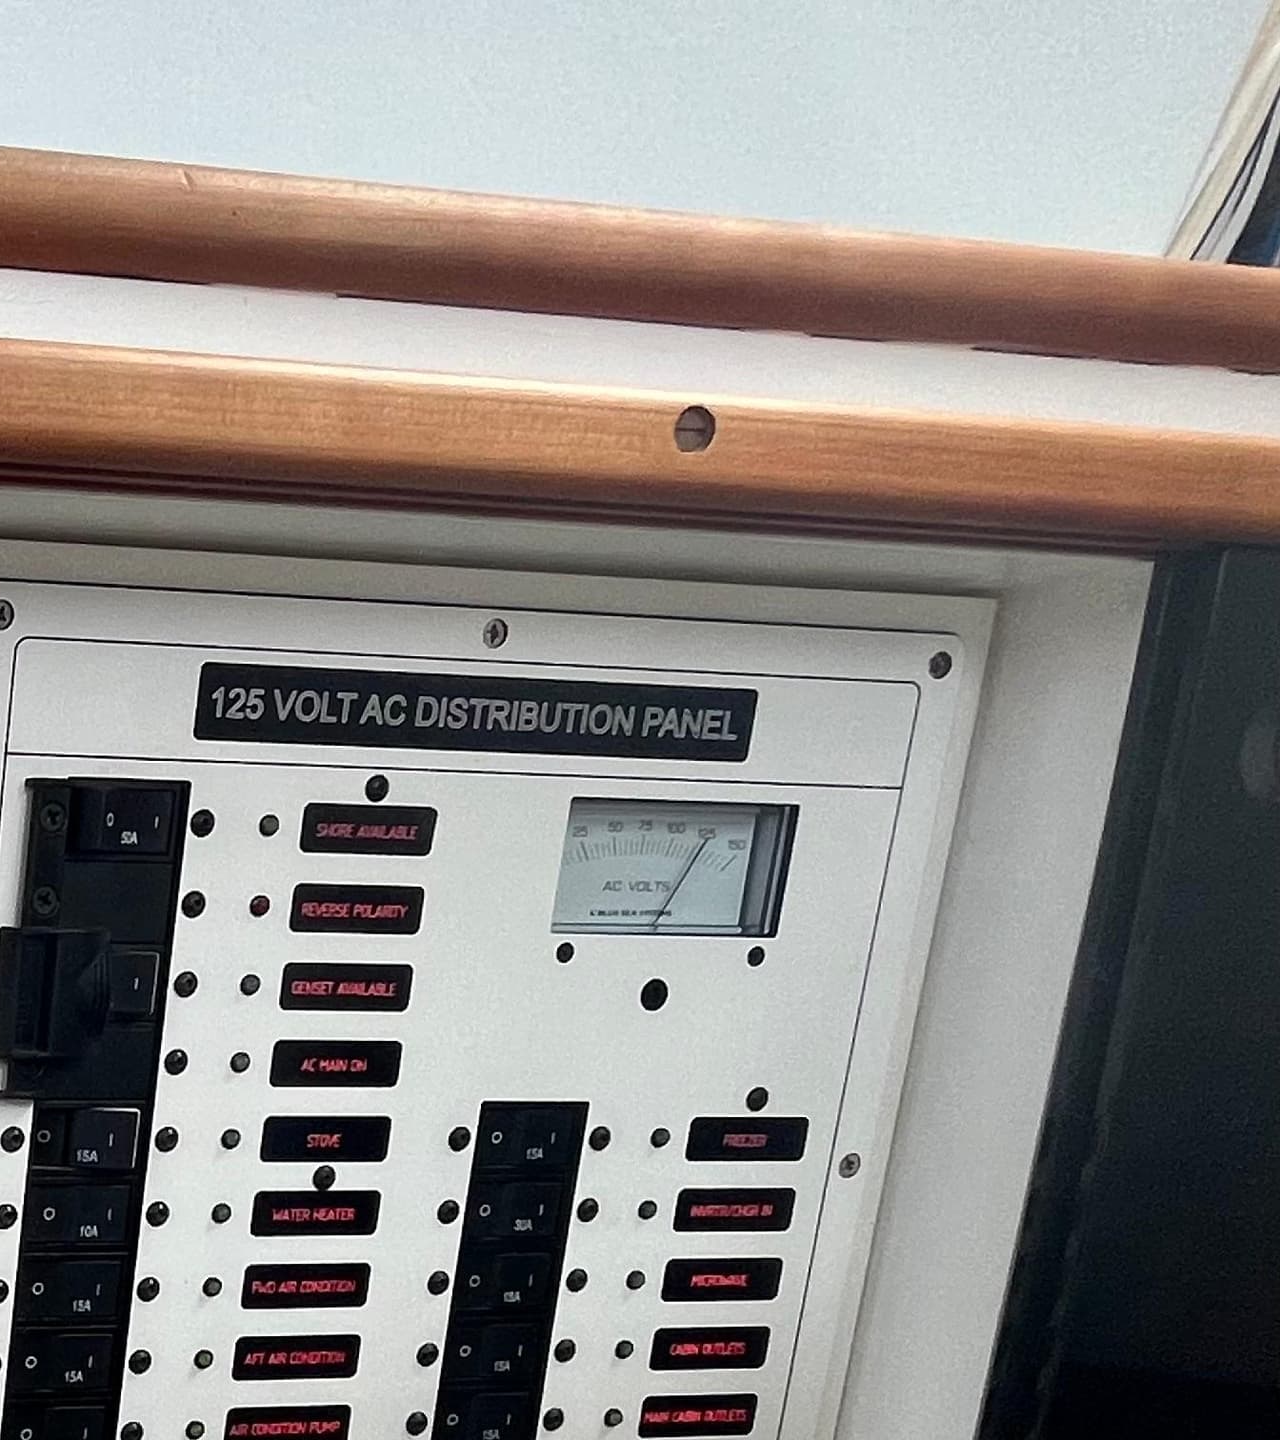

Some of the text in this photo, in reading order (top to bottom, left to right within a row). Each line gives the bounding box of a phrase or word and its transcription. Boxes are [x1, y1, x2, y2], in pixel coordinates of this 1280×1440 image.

[212, 687, 737, 740] 125 VOLT AC DISTRIBUTION PANEL
[316, 824, 418, 840] SHORE AVAILABLE
[608, 820, 624, 832] 50
[602, 881, 670, 893] AC VOLTS
[302, 903, 408, 918] REVERSE POLARITY
[292, 981, 396, 996] GENSET AVAILABLE
[301, 1058, 367, 1071] AC MAIN ON
[307, 1134, 341, 1147] STOVE
[273, 1208, 355, 1221] WATER HEATER
[252, 1280, 355, 1293] FWD AIR CONDITION
[700, 1342, 745, 1355] OUTLETS
[245, 1351, 345, 1365] AFT AIR CONDITION
[644, 1409, 746, 1422] MAIN CABIN OUTLETS
[229, 1421, 340, 1435] AIR CONDITION PUMP
